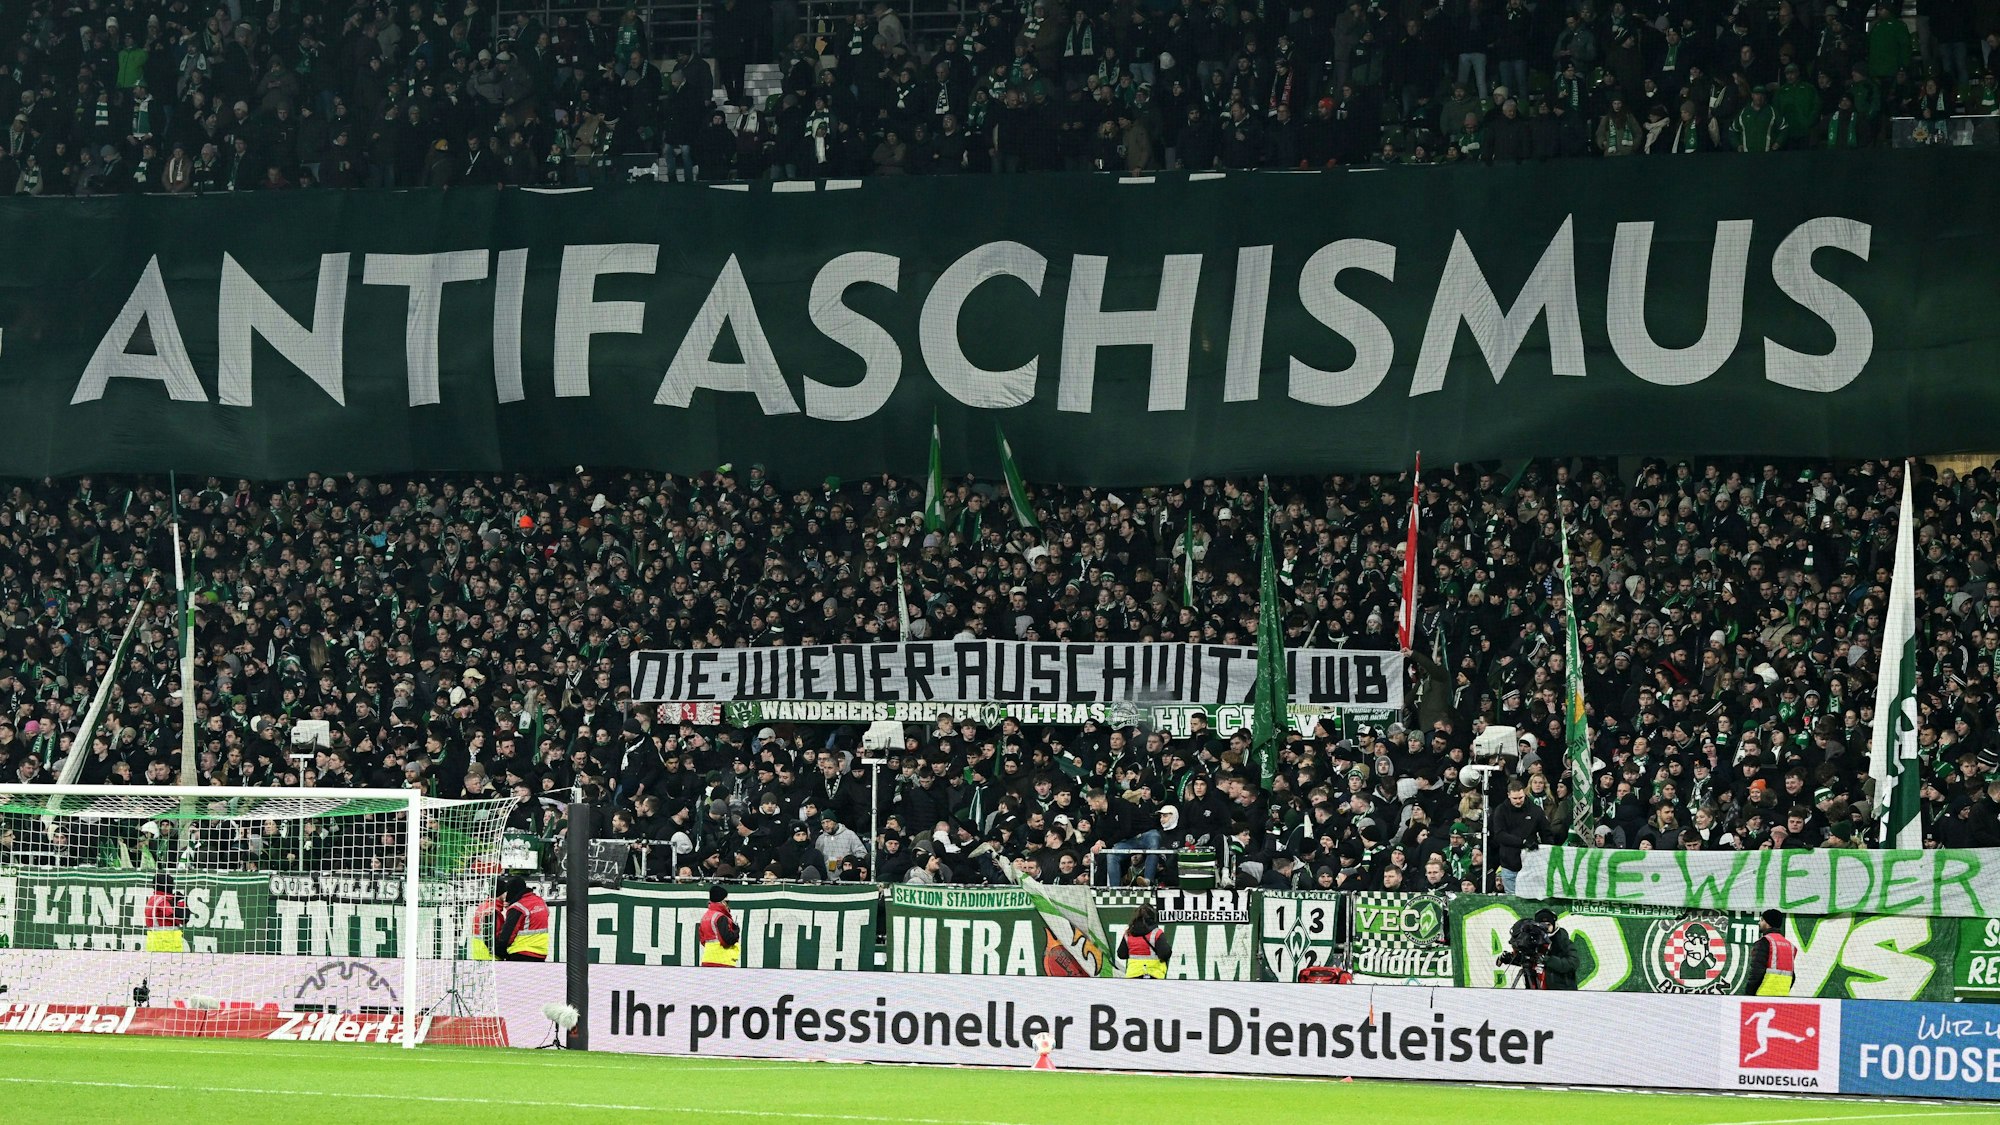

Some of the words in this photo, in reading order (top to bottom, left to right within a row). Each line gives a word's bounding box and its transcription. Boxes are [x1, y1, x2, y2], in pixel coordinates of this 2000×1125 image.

[70, 213, 1874, 421] ANTIFASCHISMUS
[1310, 656, 1388, 703] WB
[760, 701, 889, 722] WANDERERS
[894, 701, 981, 723] BREMEN
[1007, 703, 1105, 723] ULTRAS
[269, 875, 316, 897] OUR
[320, 876, 375, 899] WILL
[376, 879, 400, 900] IS
[1675, 847, 1985, 916] WIEDER
[33, 885, 244, 930] L'INTSA
[896, 887, 943, 907] SEKTION
[1305, 893, 1337, 901] POLICE
[1572, 905, 1621, 914] NIEMALS
[1160, 910, 1249, 922] UNVERGESSEN
[1276, 906, 1285, 930] 1
[1309, 908, 1324, 933] 3
[1275, 948, 1283, 972] 1
[1359, 946, 1453, 977] alianza
[611, 990, 676, 1036] Ihr
[690, 994, 1074, 1052] professioneller
[1090, 1004, 1554, 1065] Bau-Dienstleister
[1738, 1074, 1819, 1088] BUNDESLIGA
